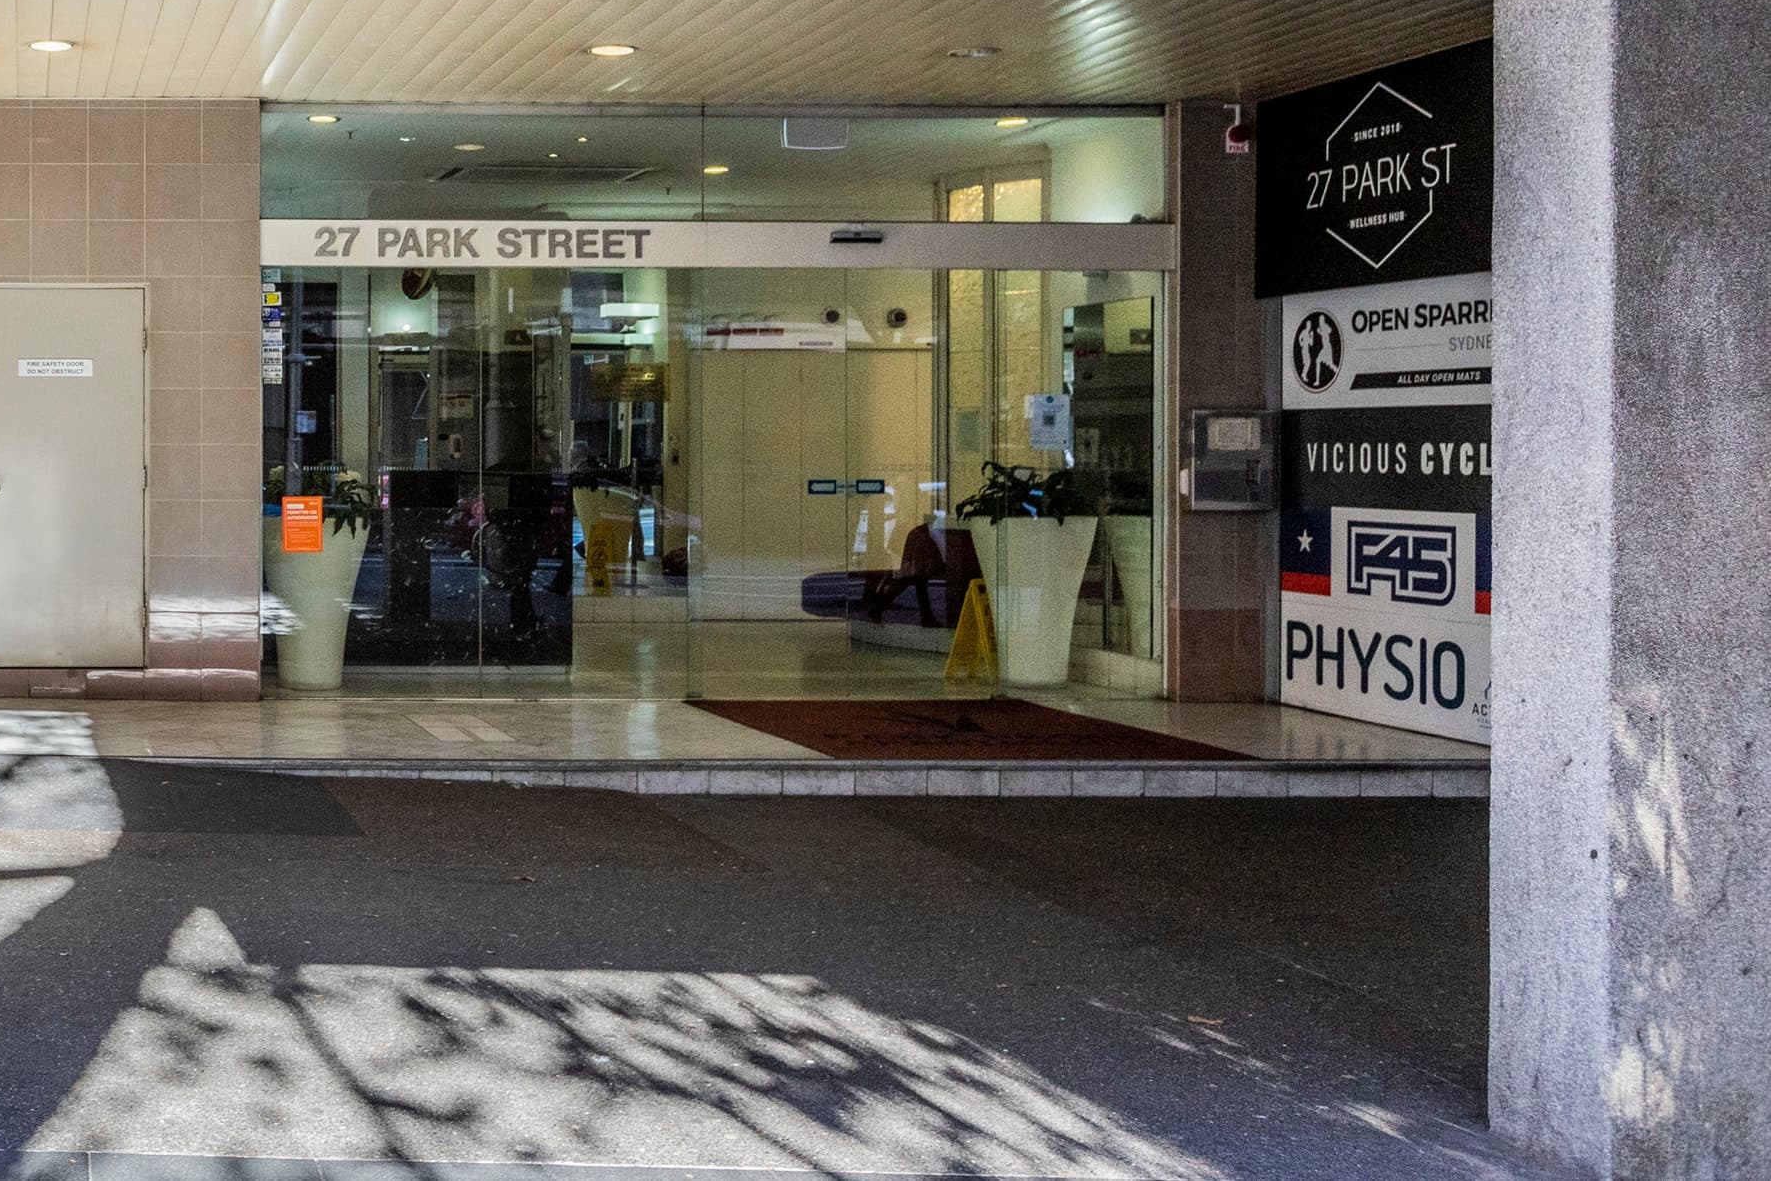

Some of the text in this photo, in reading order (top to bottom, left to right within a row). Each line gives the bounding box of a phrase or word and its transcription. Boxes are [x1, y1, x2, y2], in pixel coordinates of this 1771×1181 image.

[1354, 127, 1377, 142] SINCE
[1307, 143, 1457, 209] 27 PARK ST
[1349, 210, 1404, 229] WELLNESS HUB
[314, 227, 651, 259] 27 PARK STREET
[1351, 307, 1409, 333] OPEN
[1397, 371, 1480, 384] ALL DAY OPEN MATS
[1307, 442, 1492, 476] VICIOUS CYCL
[1349, 523, 1455, 604] F45
[1286, 620, 1466, 709] PHYSIO
[1472, 703, 1491, 716] AC
